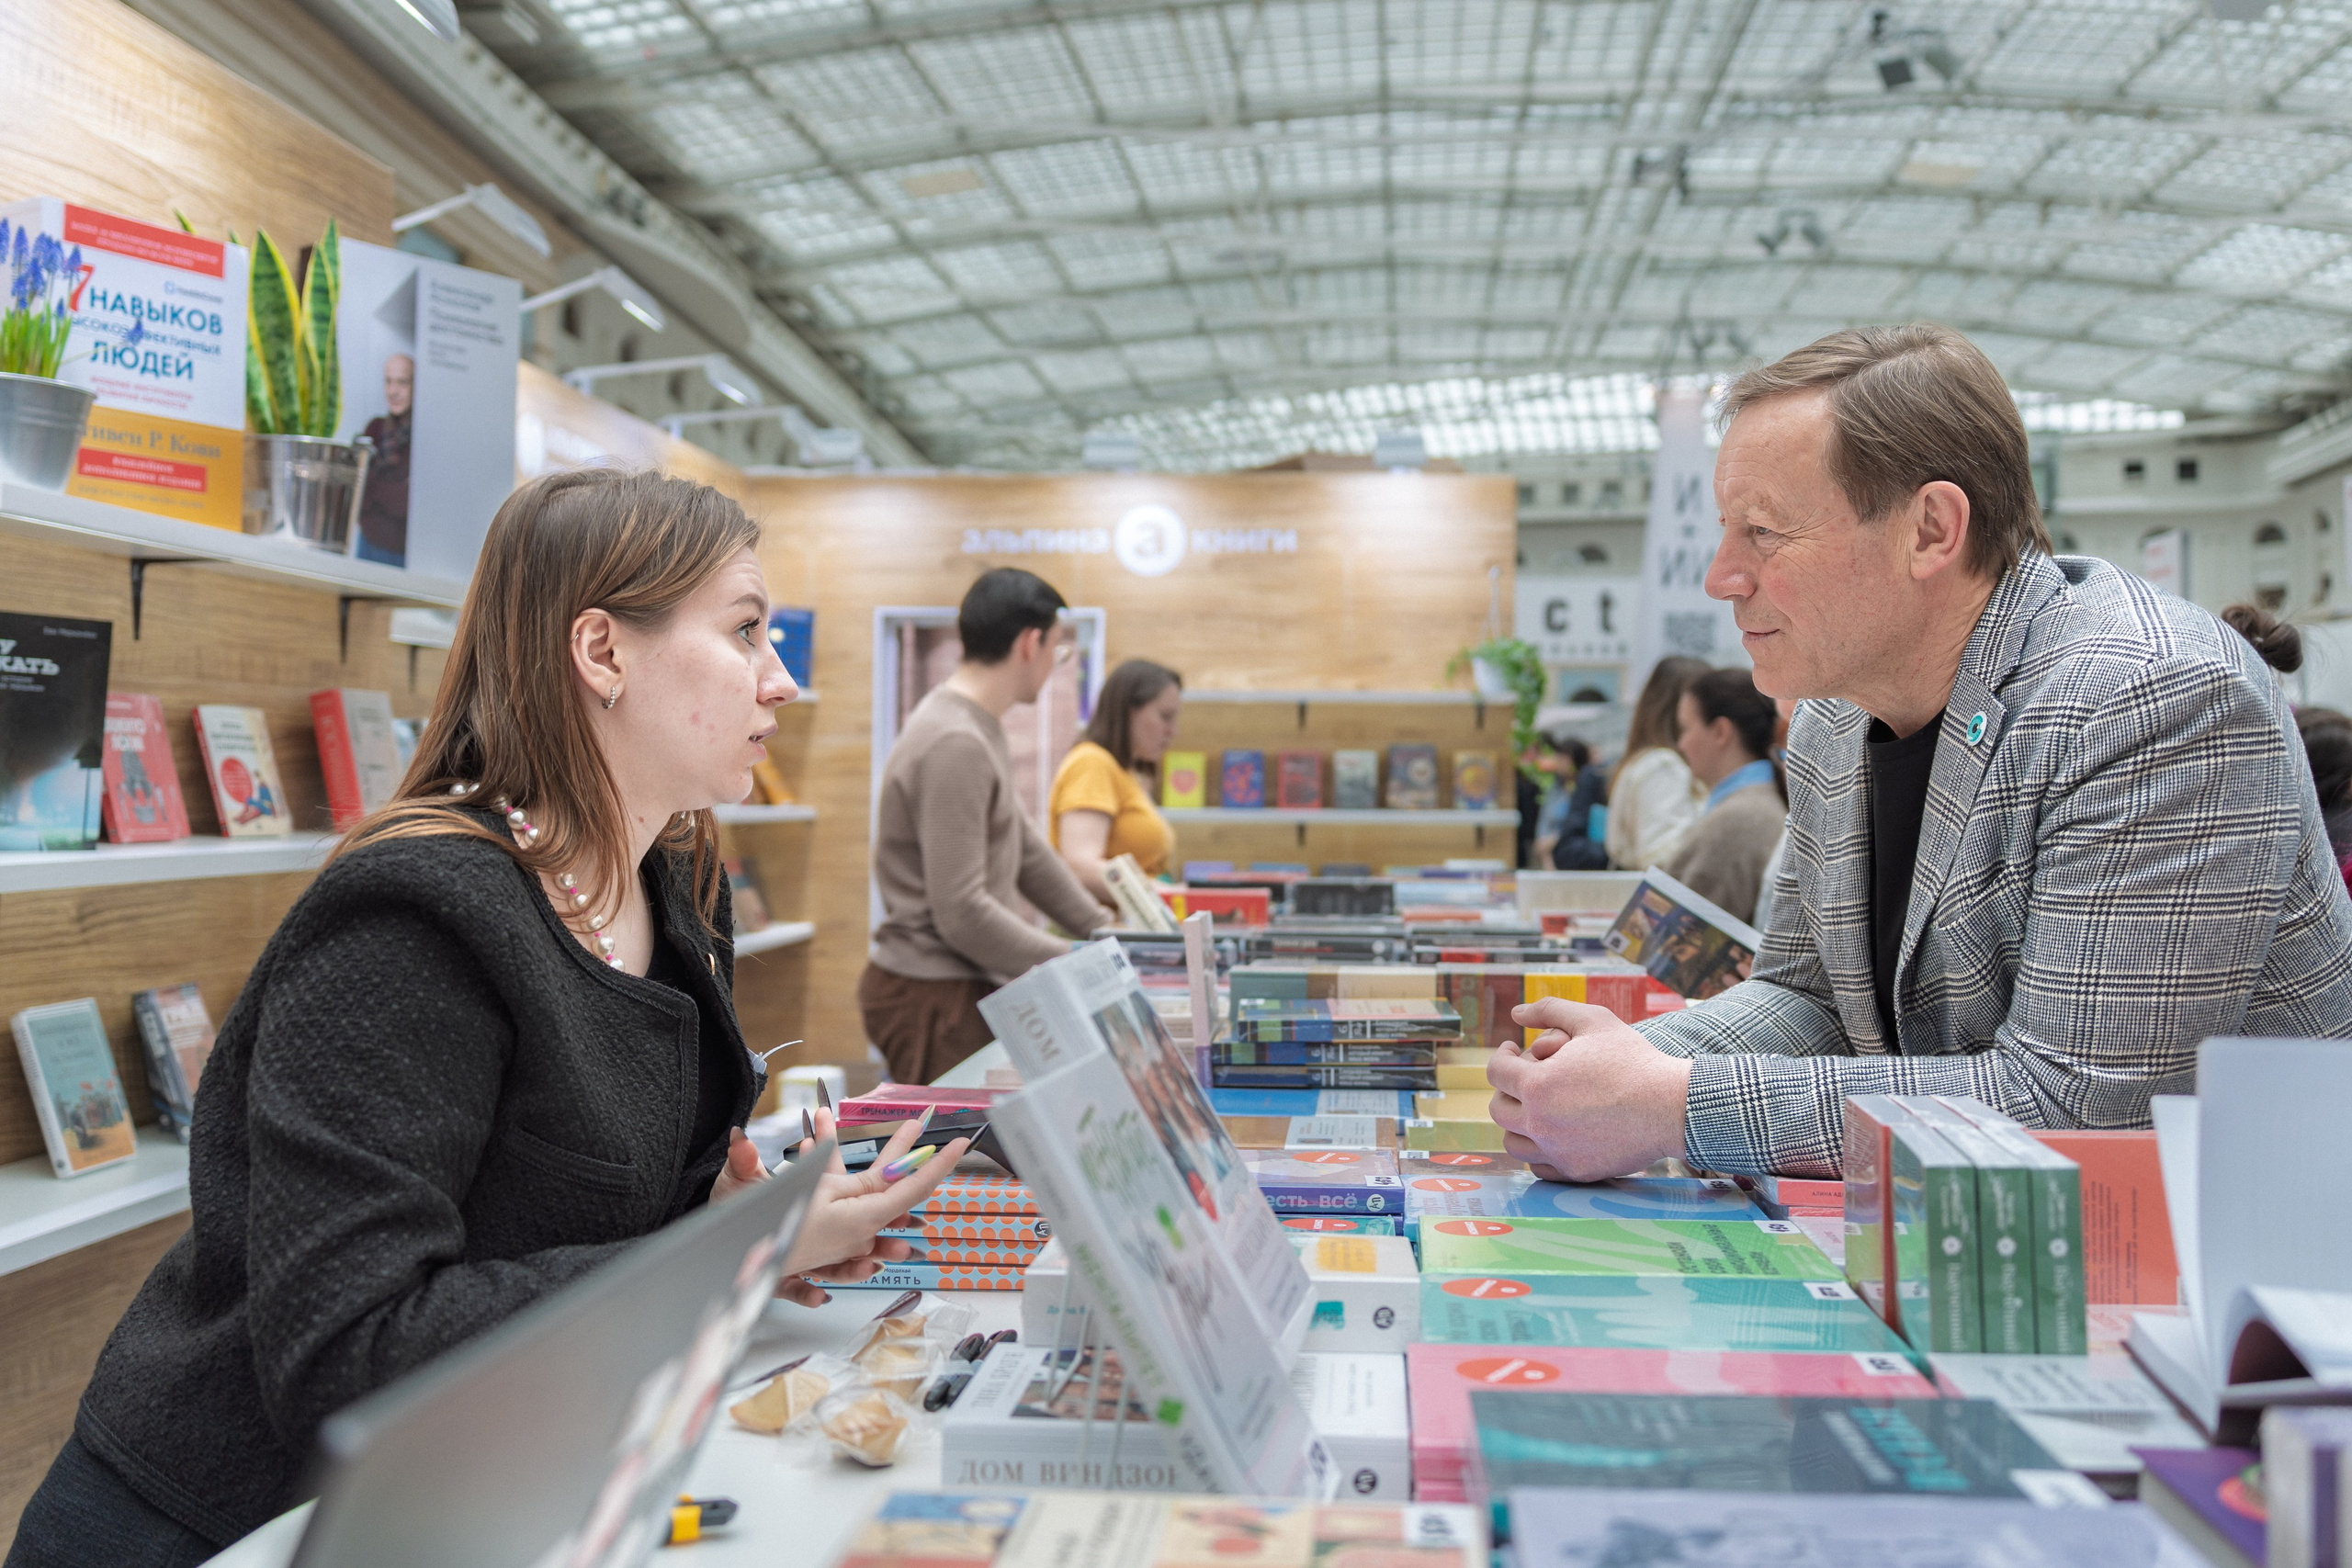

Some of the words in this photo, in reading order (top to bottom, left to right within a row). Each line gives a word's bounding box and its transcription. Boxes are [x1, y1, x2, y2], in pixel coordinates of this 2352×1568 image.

[90, 287, 222, 335] НАВЫКОВ
[91, 341, 193, 380] ЛЮДЕЙ
[861, 1107, 907, 1116] ТРЕНАЖЕР
[958, 1460, 1024, 1485] ДОМ
